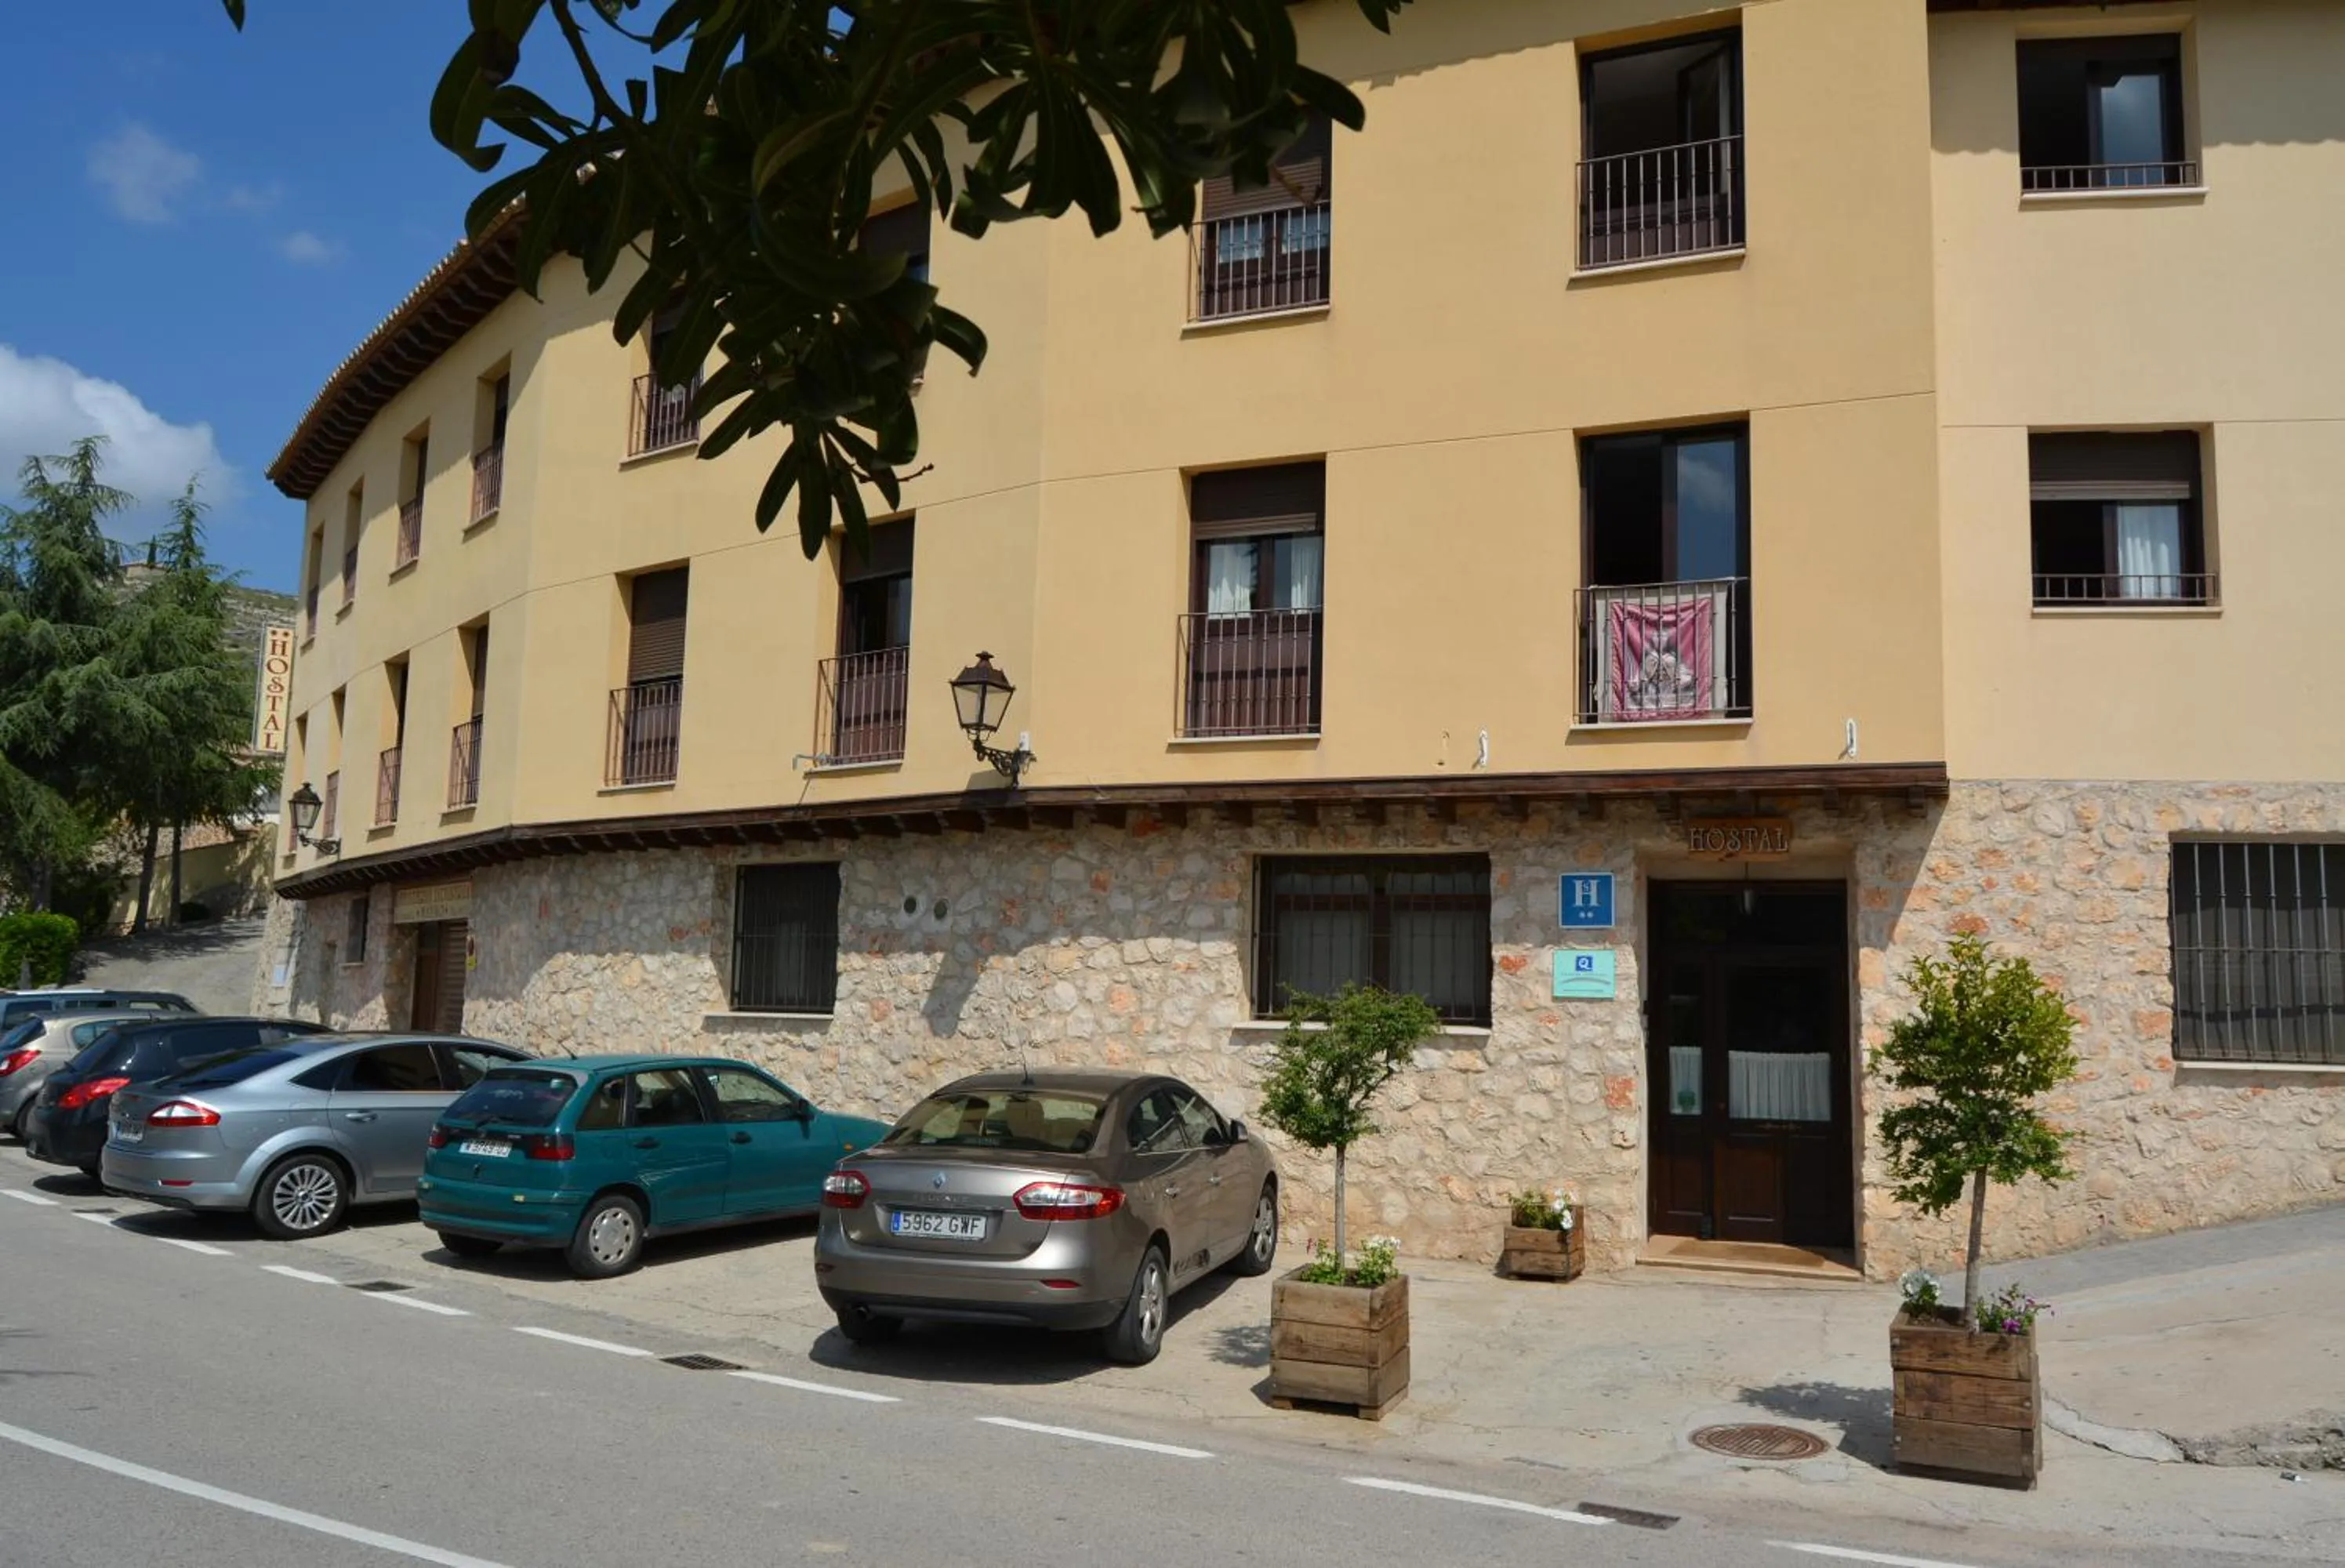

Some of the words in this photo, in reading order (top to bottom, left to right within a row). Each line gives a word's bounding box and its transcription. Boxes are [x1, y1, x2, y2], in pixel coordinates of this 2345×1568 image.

[263, 639, 289, 750] HOSTAL
[1689, 827, 1788, 851] HOSTAL
[902, 1212, 943, 1232] 5962
[948, 1216, 982, 1235] GWF
